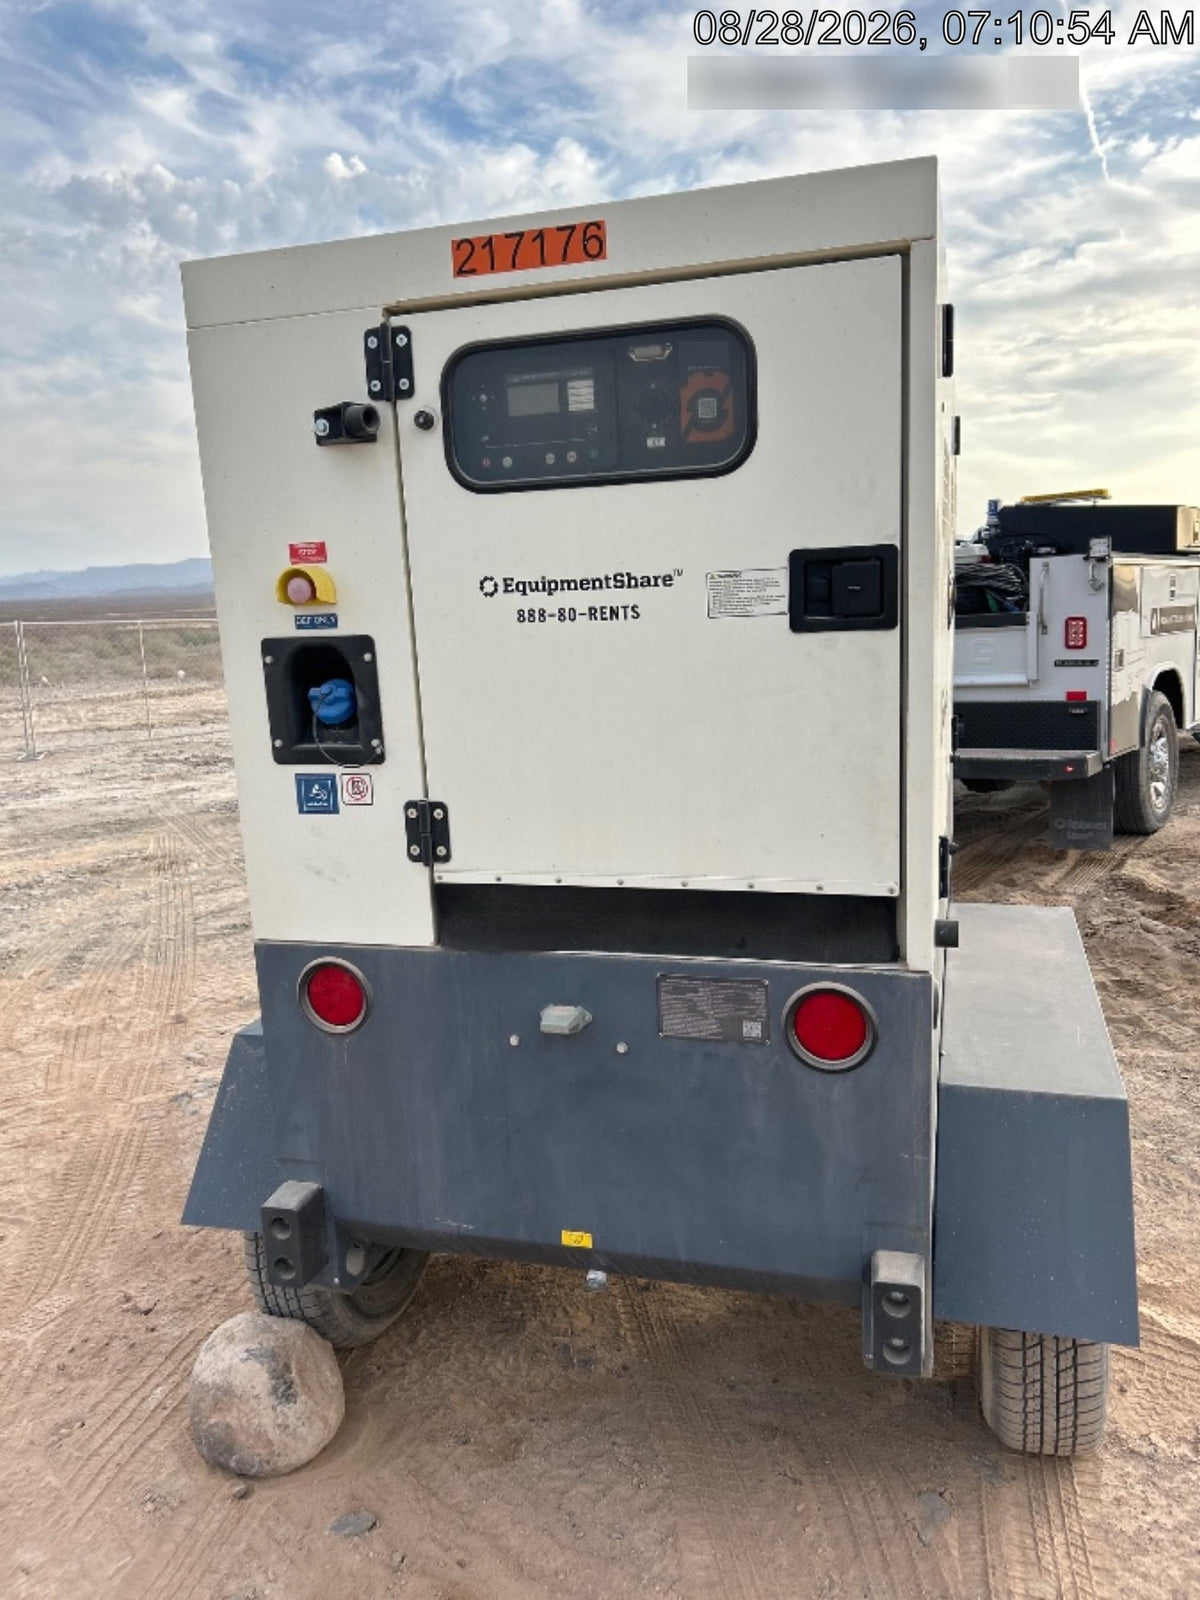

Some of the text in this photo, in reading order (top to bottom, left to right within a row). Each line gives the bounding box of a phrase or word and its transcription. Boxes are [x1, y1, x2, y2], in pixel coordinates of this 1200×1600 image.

[456, 221, 604, 276] 217176
[502, 572, 674, 596] EquipmentShare
[516, 604, 641, 623] 888-80-RENTS
